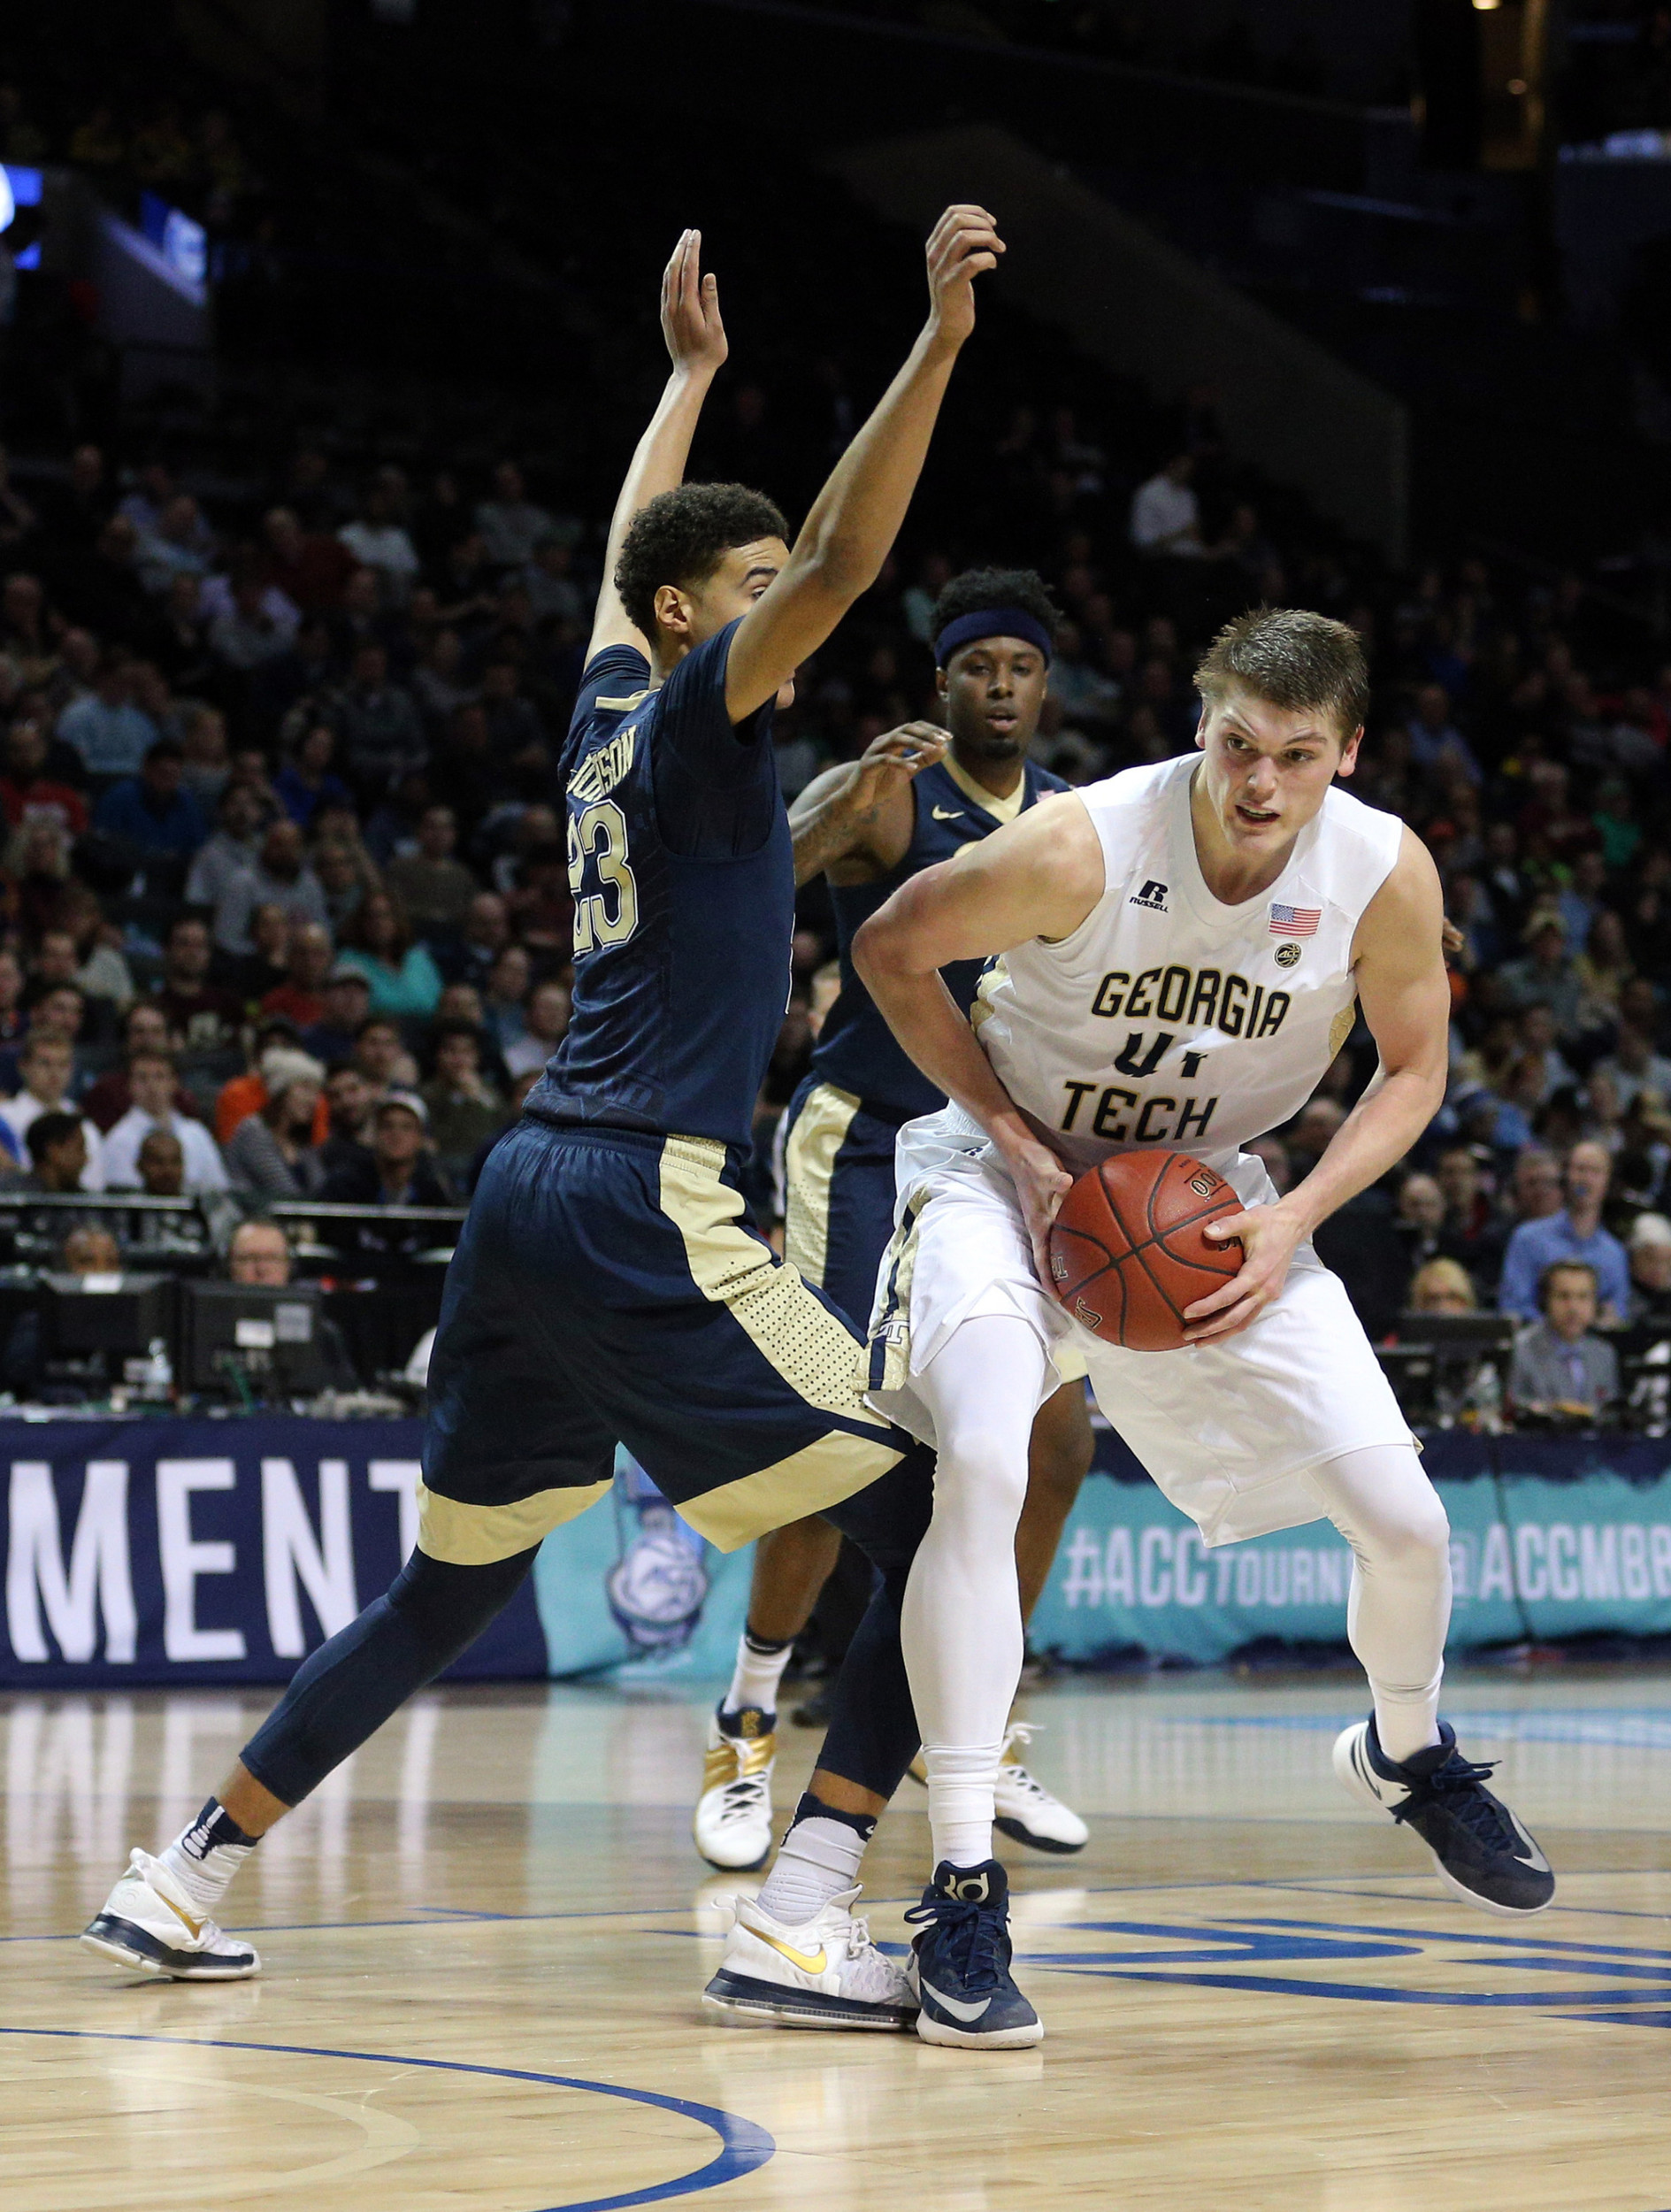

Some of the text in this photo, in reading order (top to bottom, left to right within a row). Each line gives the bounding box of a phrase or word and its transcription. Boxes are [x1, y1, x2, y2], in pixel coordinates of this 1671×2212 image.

[566, 798, 640, 956] 23
[1129, 896, 1169, 914] RUSSELL
[1092, 964, 1292, 1039] GEORGIA
[1061, 1080, 1218, 1142] TECH
[1062, 1525, 1354, 1608] #ACCTOURN
